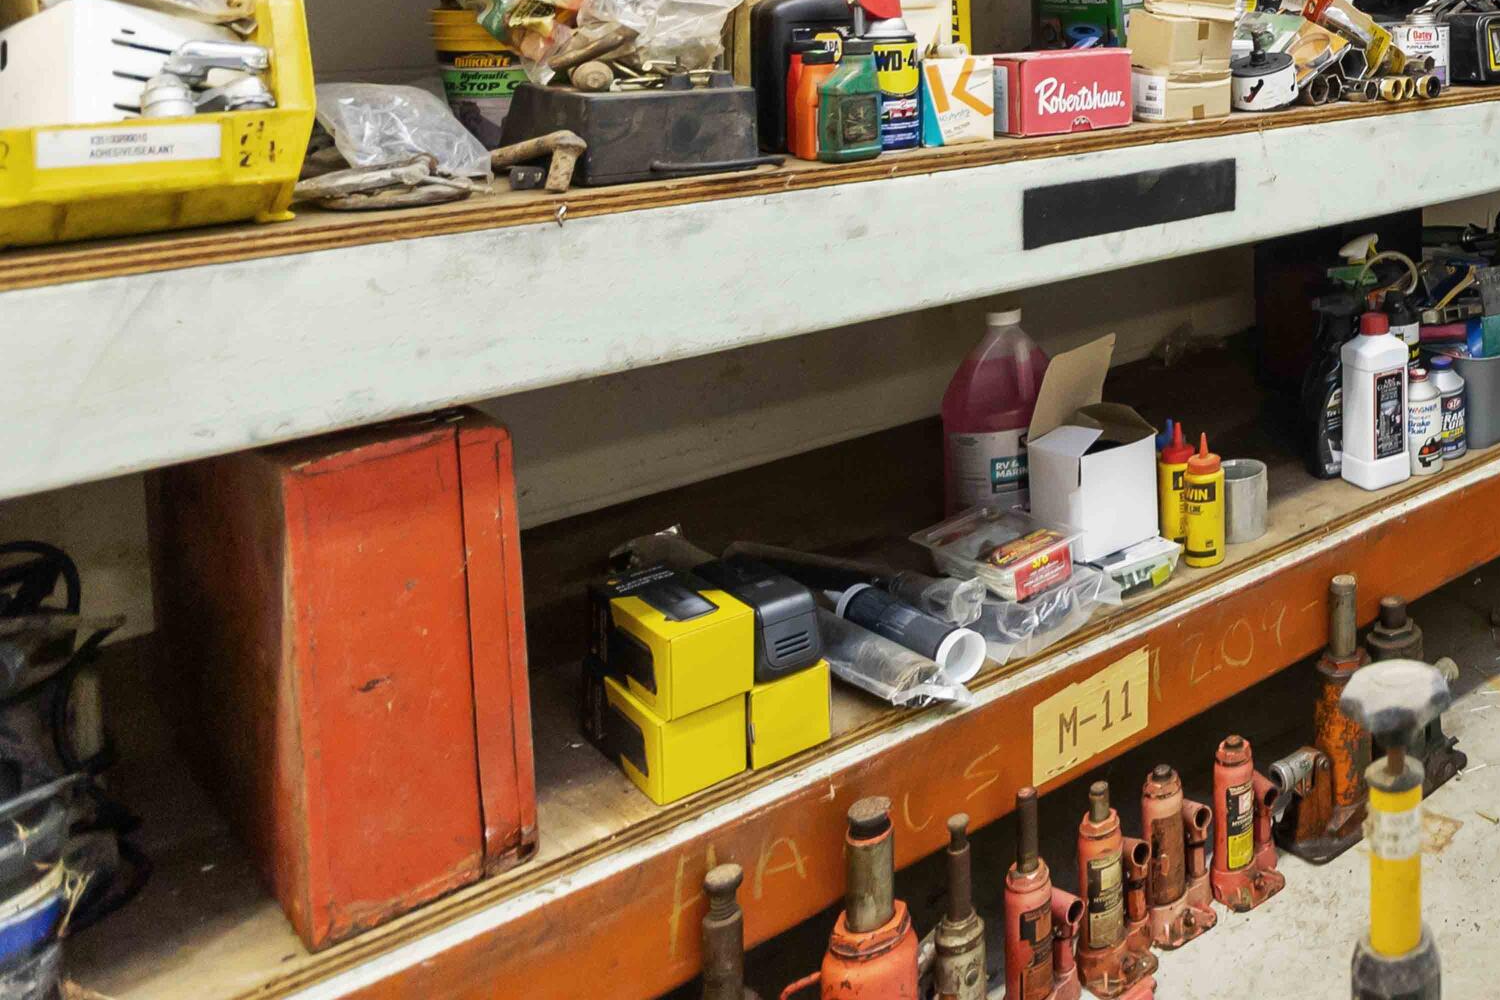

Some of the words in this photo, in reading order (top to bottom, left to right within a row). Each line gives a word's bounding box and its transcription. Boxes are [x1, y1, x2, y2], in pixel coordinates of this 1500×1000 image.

[1412, 30, 1434, 41] Oatey
[454, 56, 511, 68] QUIKRETE
[875, 50, 917, 72] WD-4
[460, 71, 509, 84] Hydraulic
[1034, 77, 1123, 116] Robertshaw
[995, 461, 1008, 470] RV
[995, 467, 1028, 479] MARIN
[1057, 680, 1133, 754] M-11
